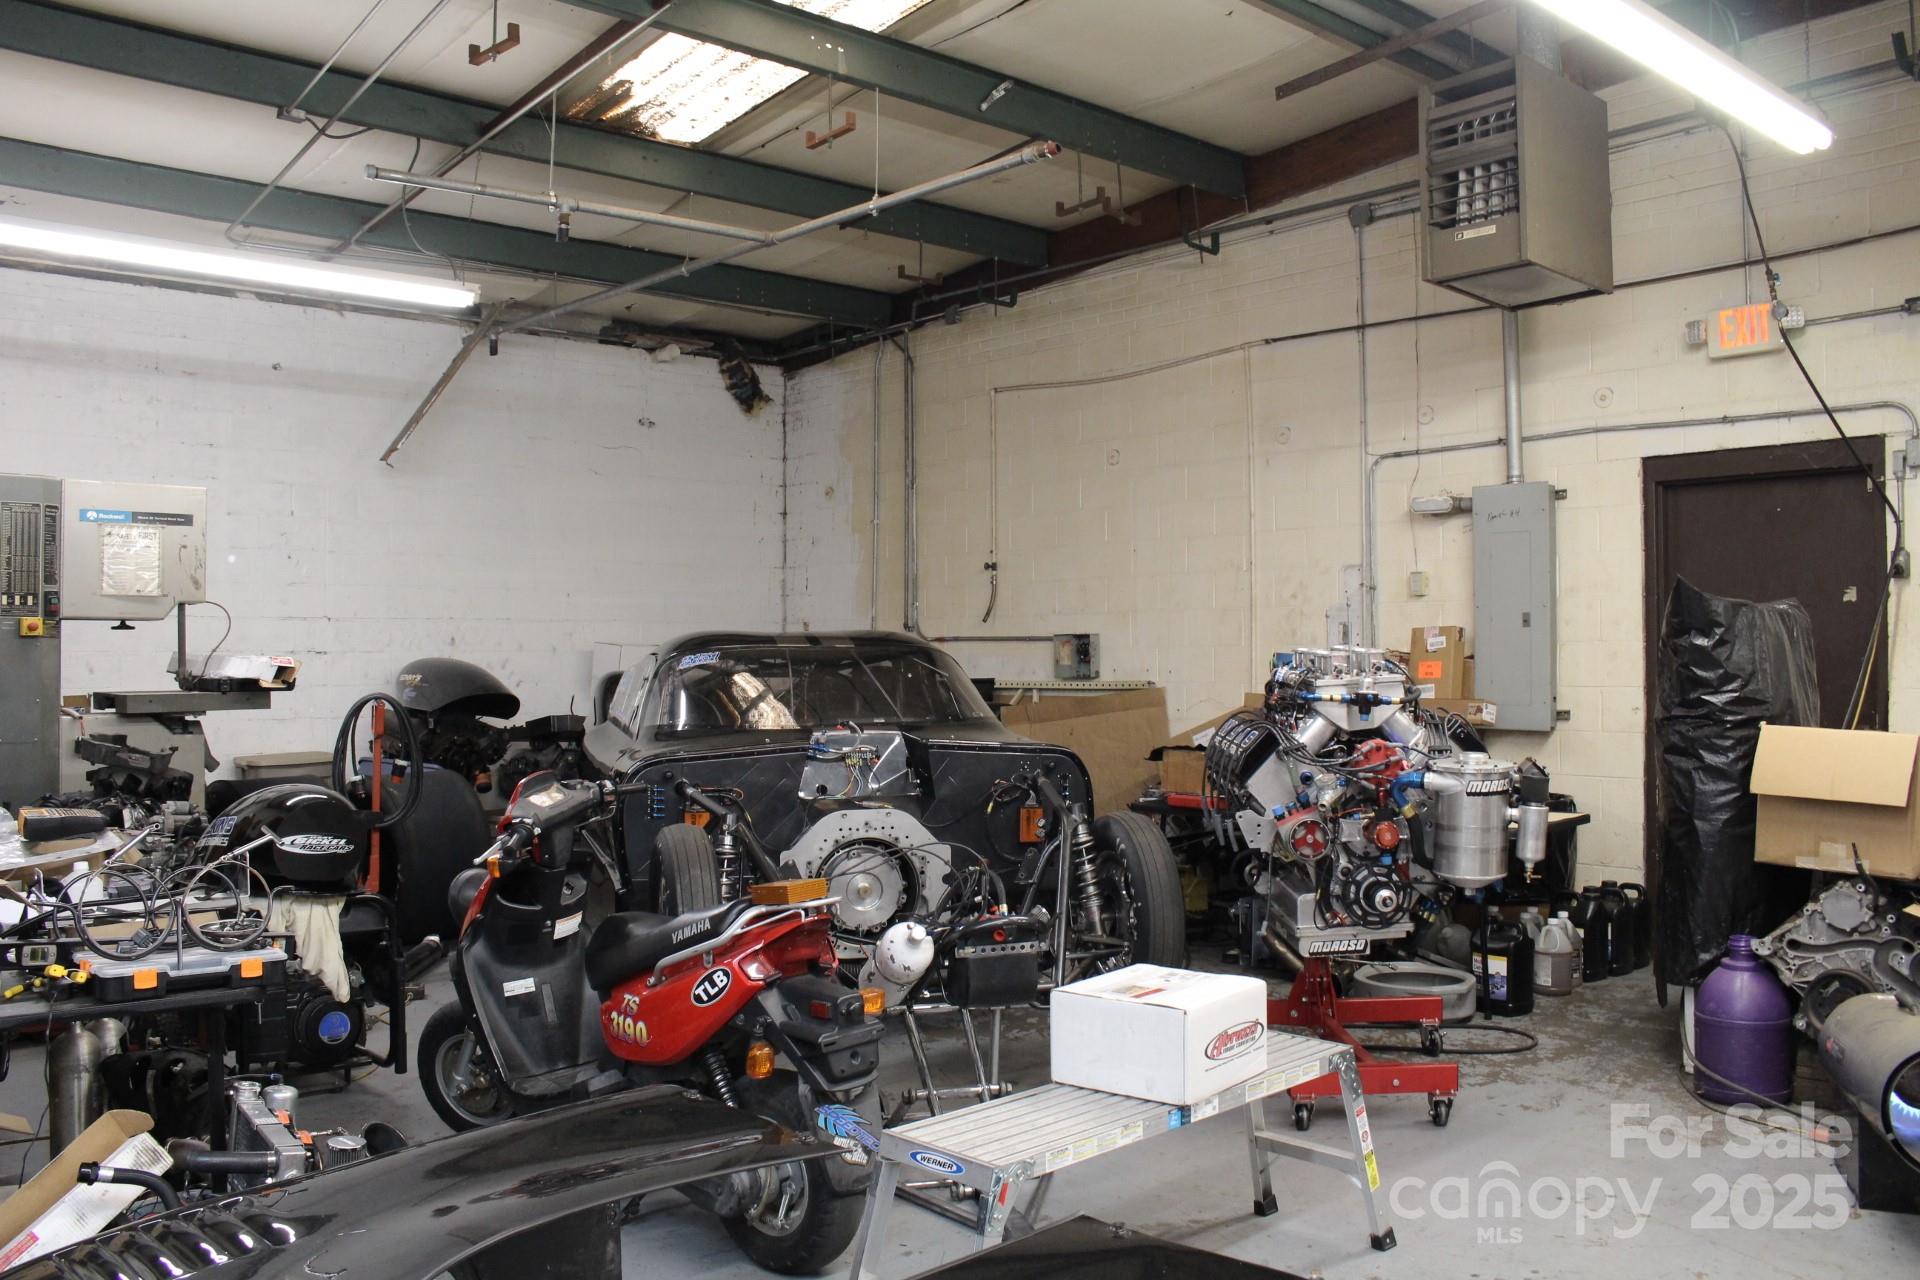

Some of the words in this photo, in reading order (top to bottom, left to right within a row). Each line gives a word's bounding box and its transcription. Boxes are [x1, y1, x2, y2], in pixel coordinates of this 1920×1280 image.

[1718, 303, 1772, 349] EXIT
[1466, 779, 1510, 793] MOROS
[671, 918, 711, 944] YAMAHA
[1309, 939, 1368, 954] MOROSO
[695, 970, 728, 1002] TLB
[622, 993, 640, 1014] TS
[610, 1010, 649, 1046] 3190
[920, 1154, 954, 1171] WERNER
